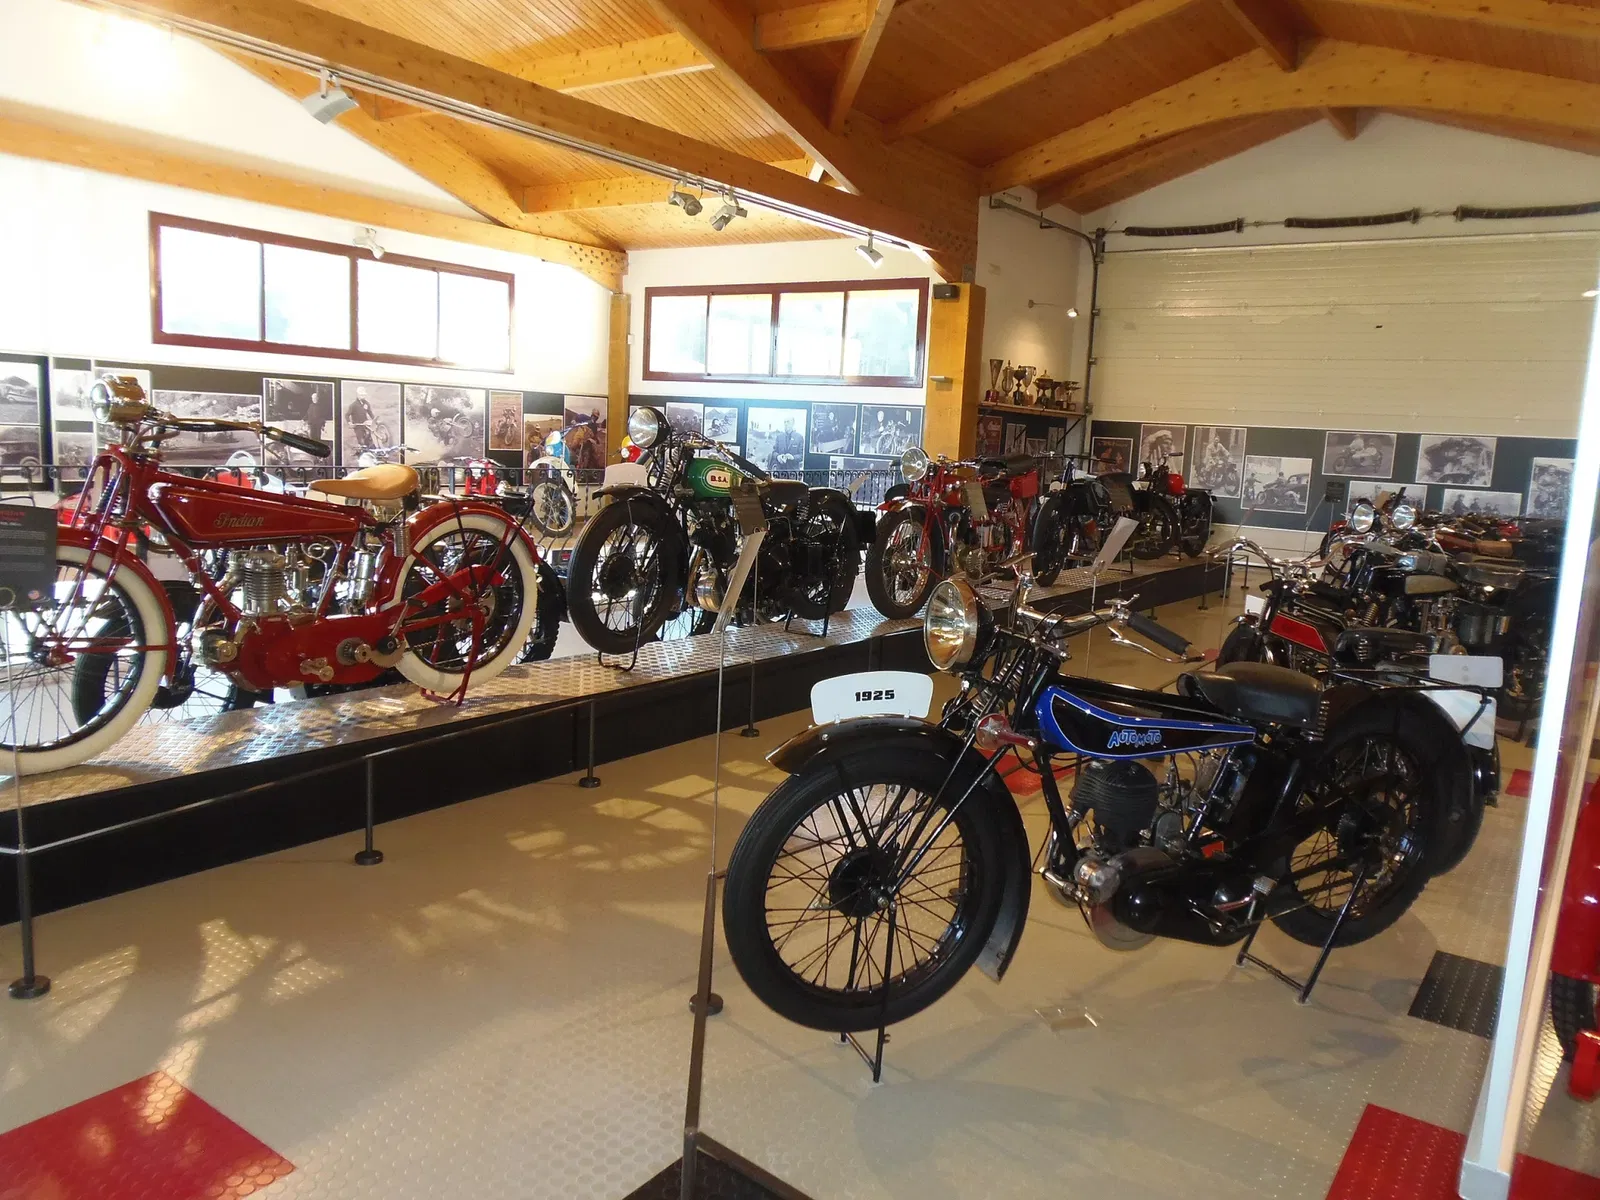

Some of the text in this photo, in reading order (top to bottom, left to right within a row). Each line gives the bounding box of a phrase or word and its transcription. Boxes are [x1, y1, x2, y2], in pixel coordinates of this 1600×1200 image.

[710, 475, 729, 484] B.S.A.
[213, 512, 265, 529] Indian
[855, 689, 895, 702] 1925
[1107, 729, 1162, 749] AUTOMOTO
